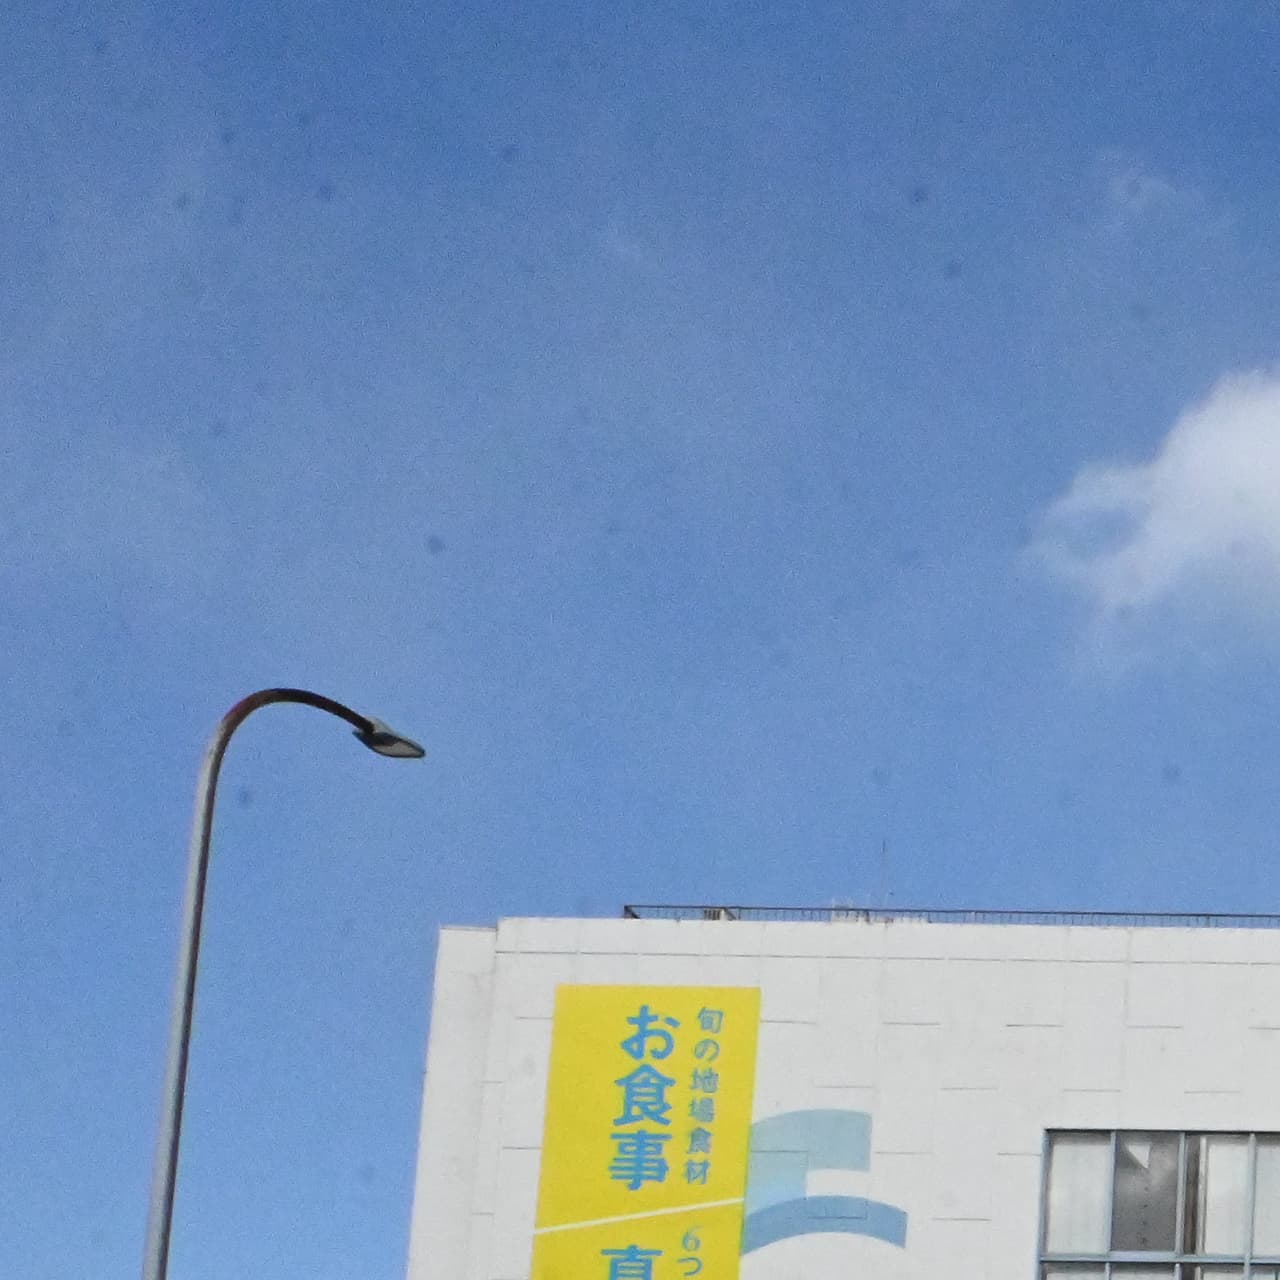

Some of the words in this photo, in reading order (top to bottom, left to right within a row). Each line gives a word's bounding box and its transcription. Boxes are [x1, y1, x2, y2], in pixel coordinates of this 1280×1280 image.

[608, 1004, 681, 1191] お食事
[684, 1006, 725, 1186] 旬の地場食材
